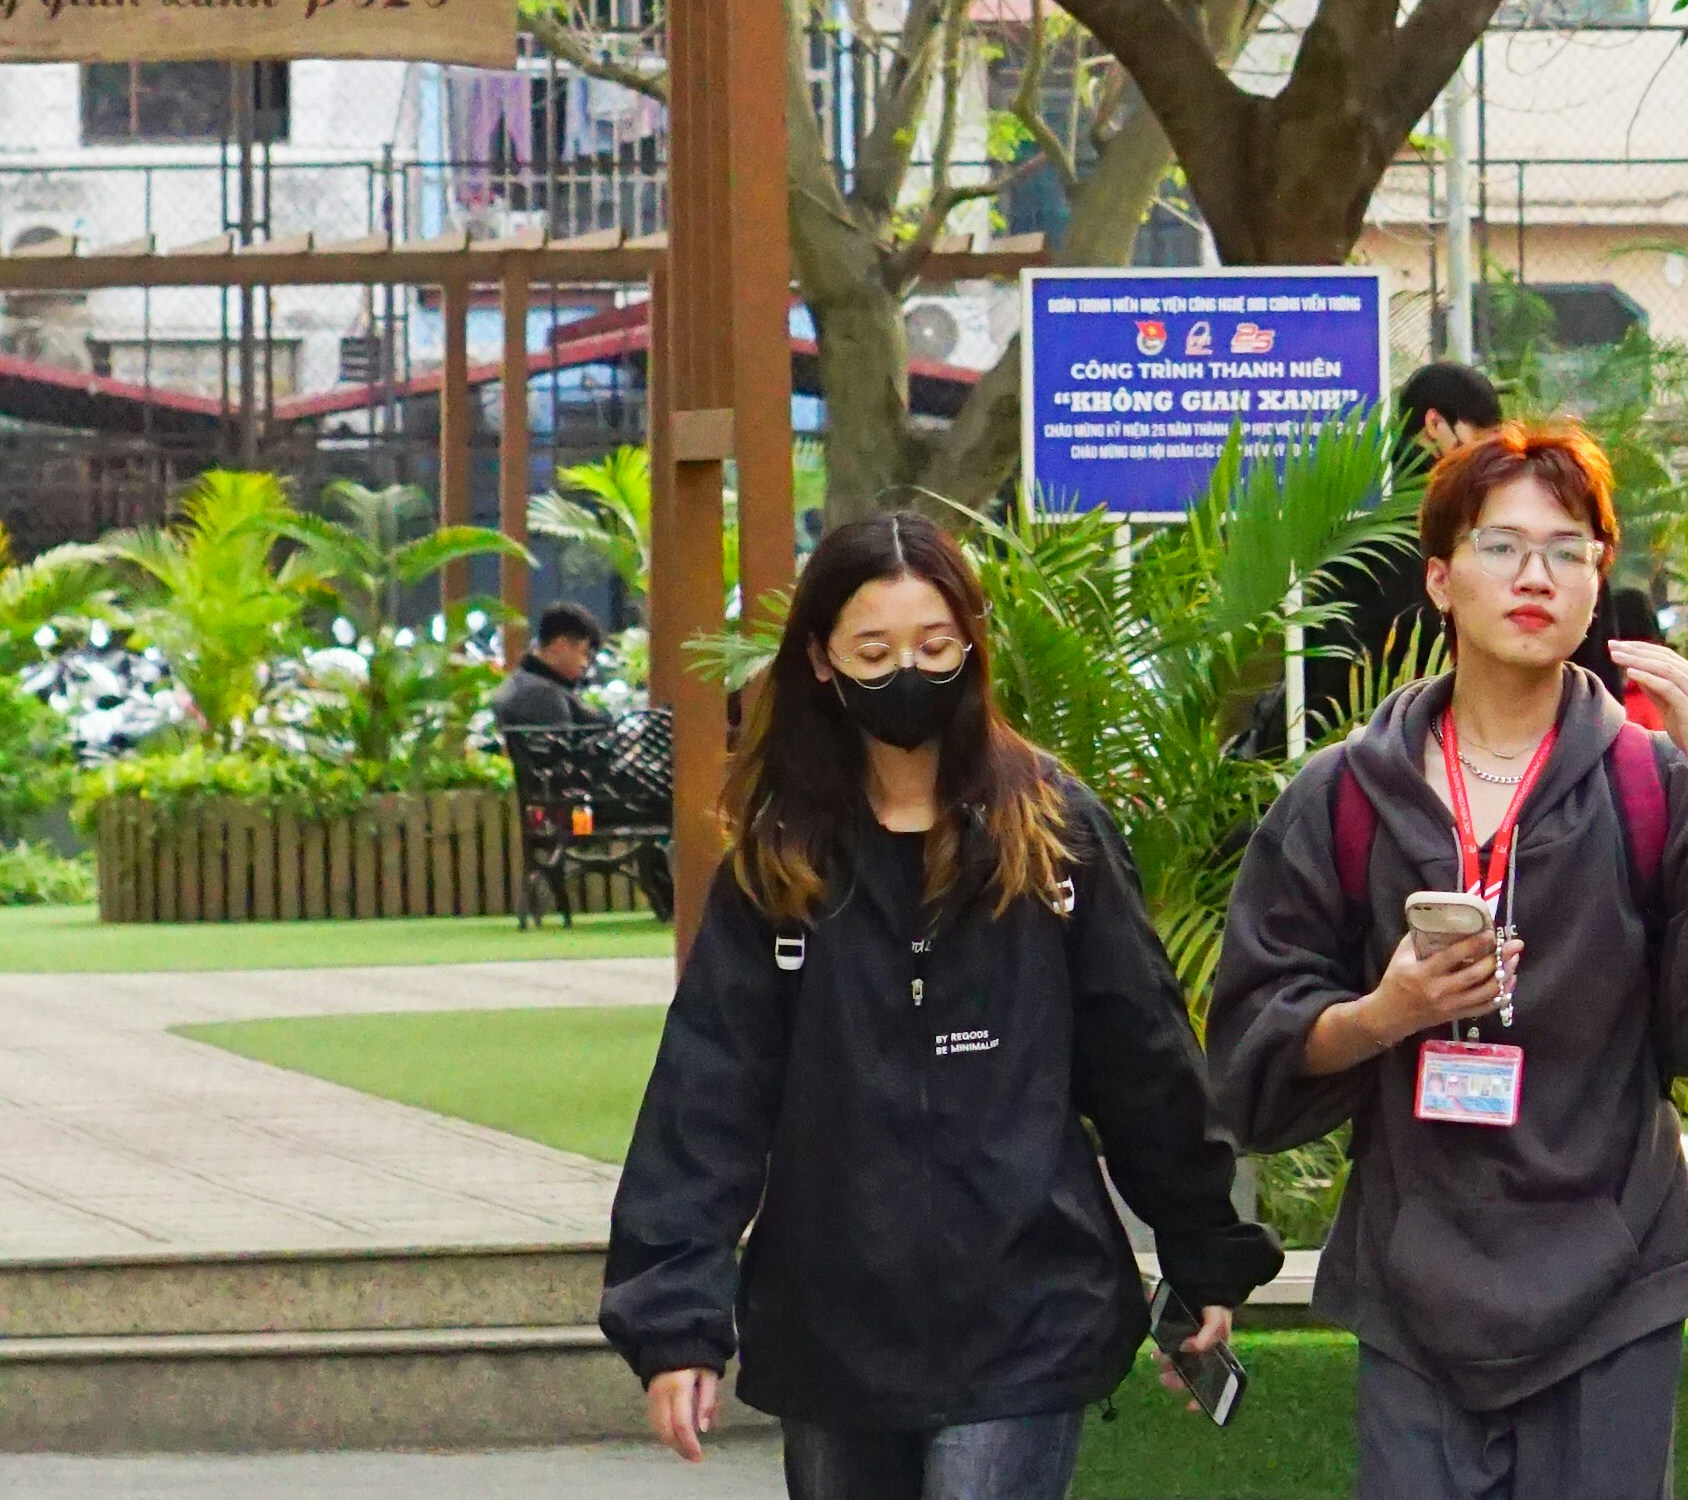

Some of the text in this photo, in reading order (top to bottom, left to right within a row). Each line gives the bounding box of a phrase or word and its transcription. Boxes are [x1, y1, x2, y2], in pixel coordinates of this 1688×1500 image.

[1070, 357, 1342, 380] CÔNG TRÌNH THANH NIÊN
[1181, 389, 1250, 412] GIAN
[935, 1035, 949, 1044] BY
[935, 1046, 948, 1056] BE
